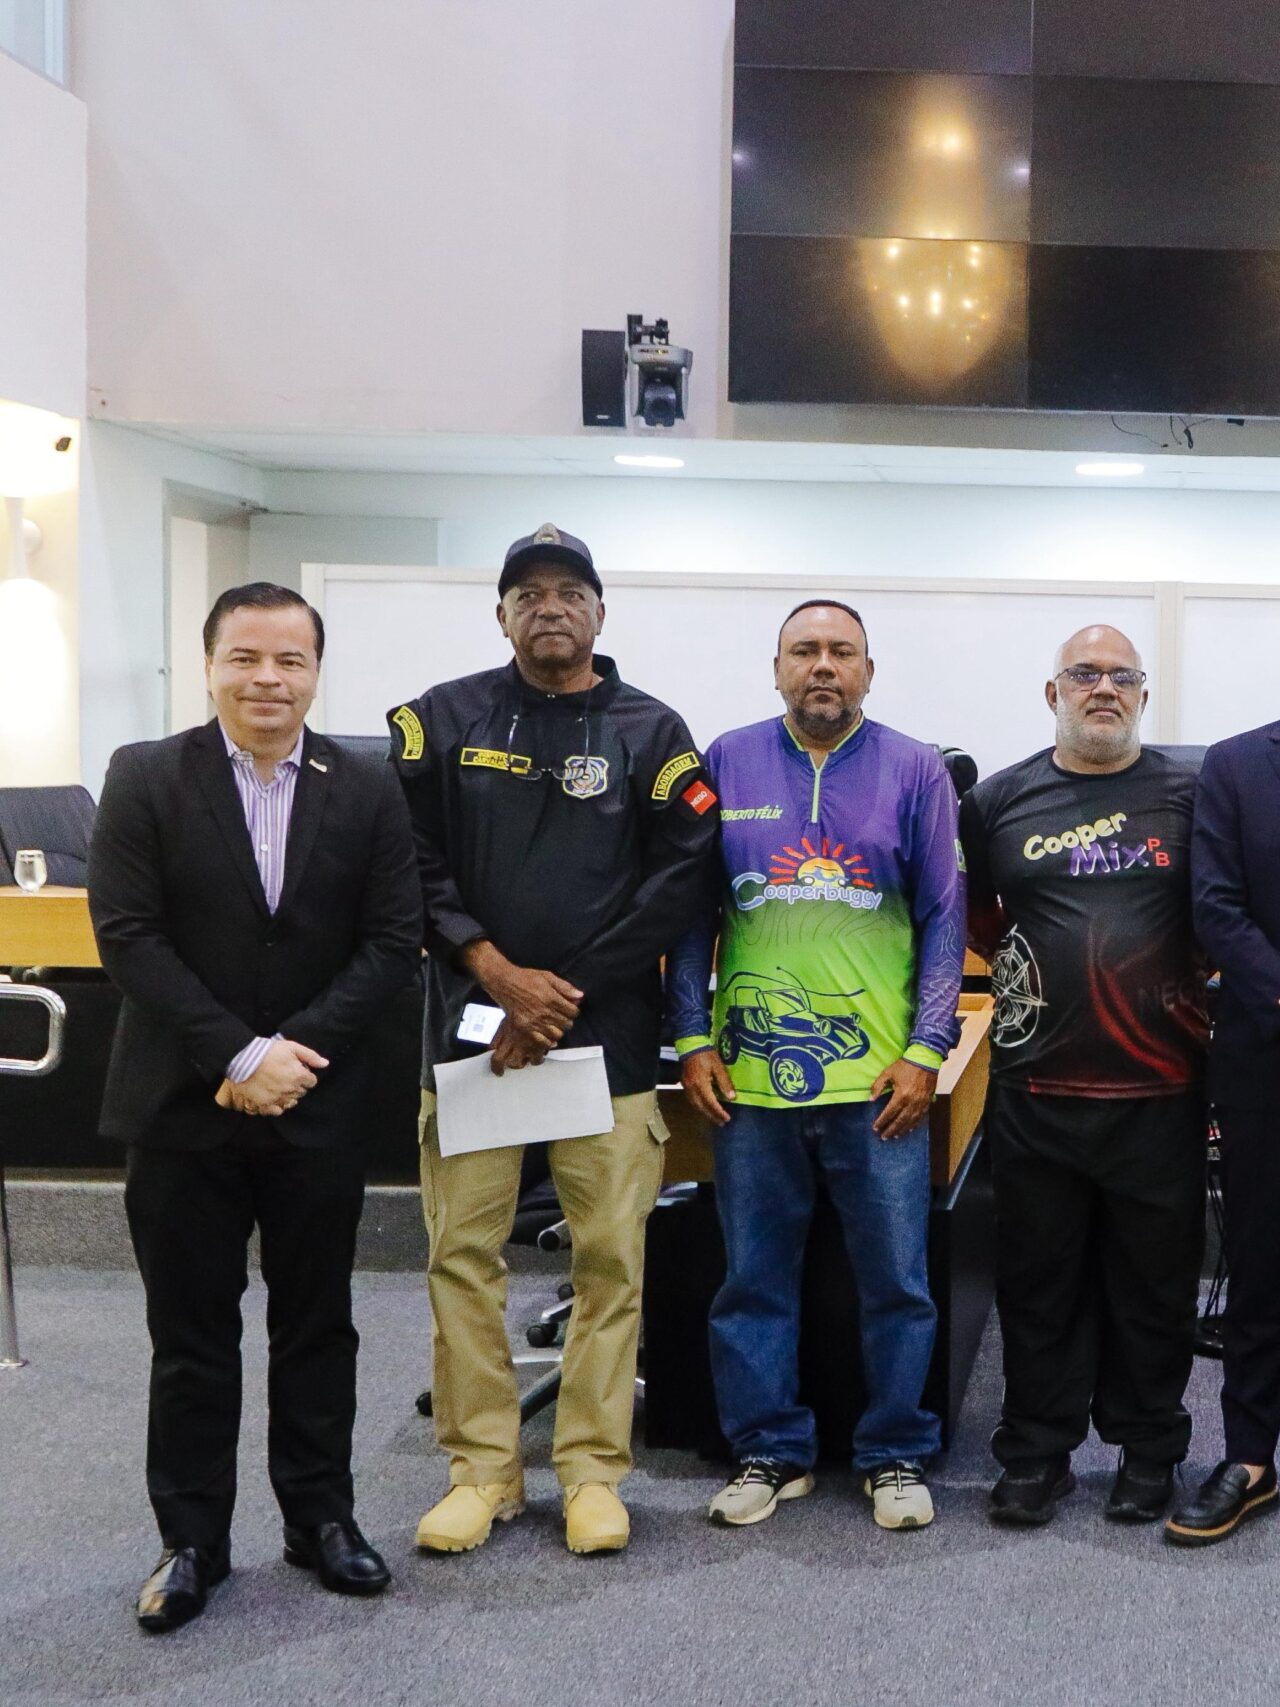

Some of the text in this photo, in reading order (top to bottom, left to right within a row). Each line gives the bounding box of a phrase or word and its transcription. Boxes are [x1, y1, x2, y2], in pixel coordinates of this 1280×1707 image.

[656, 756, 692, 796] ABORDAGEM
[754, 804, 783, 820] FÉLIX
[1023, 812, 1127, 861] Cooper
[1070, 841, 1149, 876] Mix
[731, 872, 882, 911] Cooperbuggy
